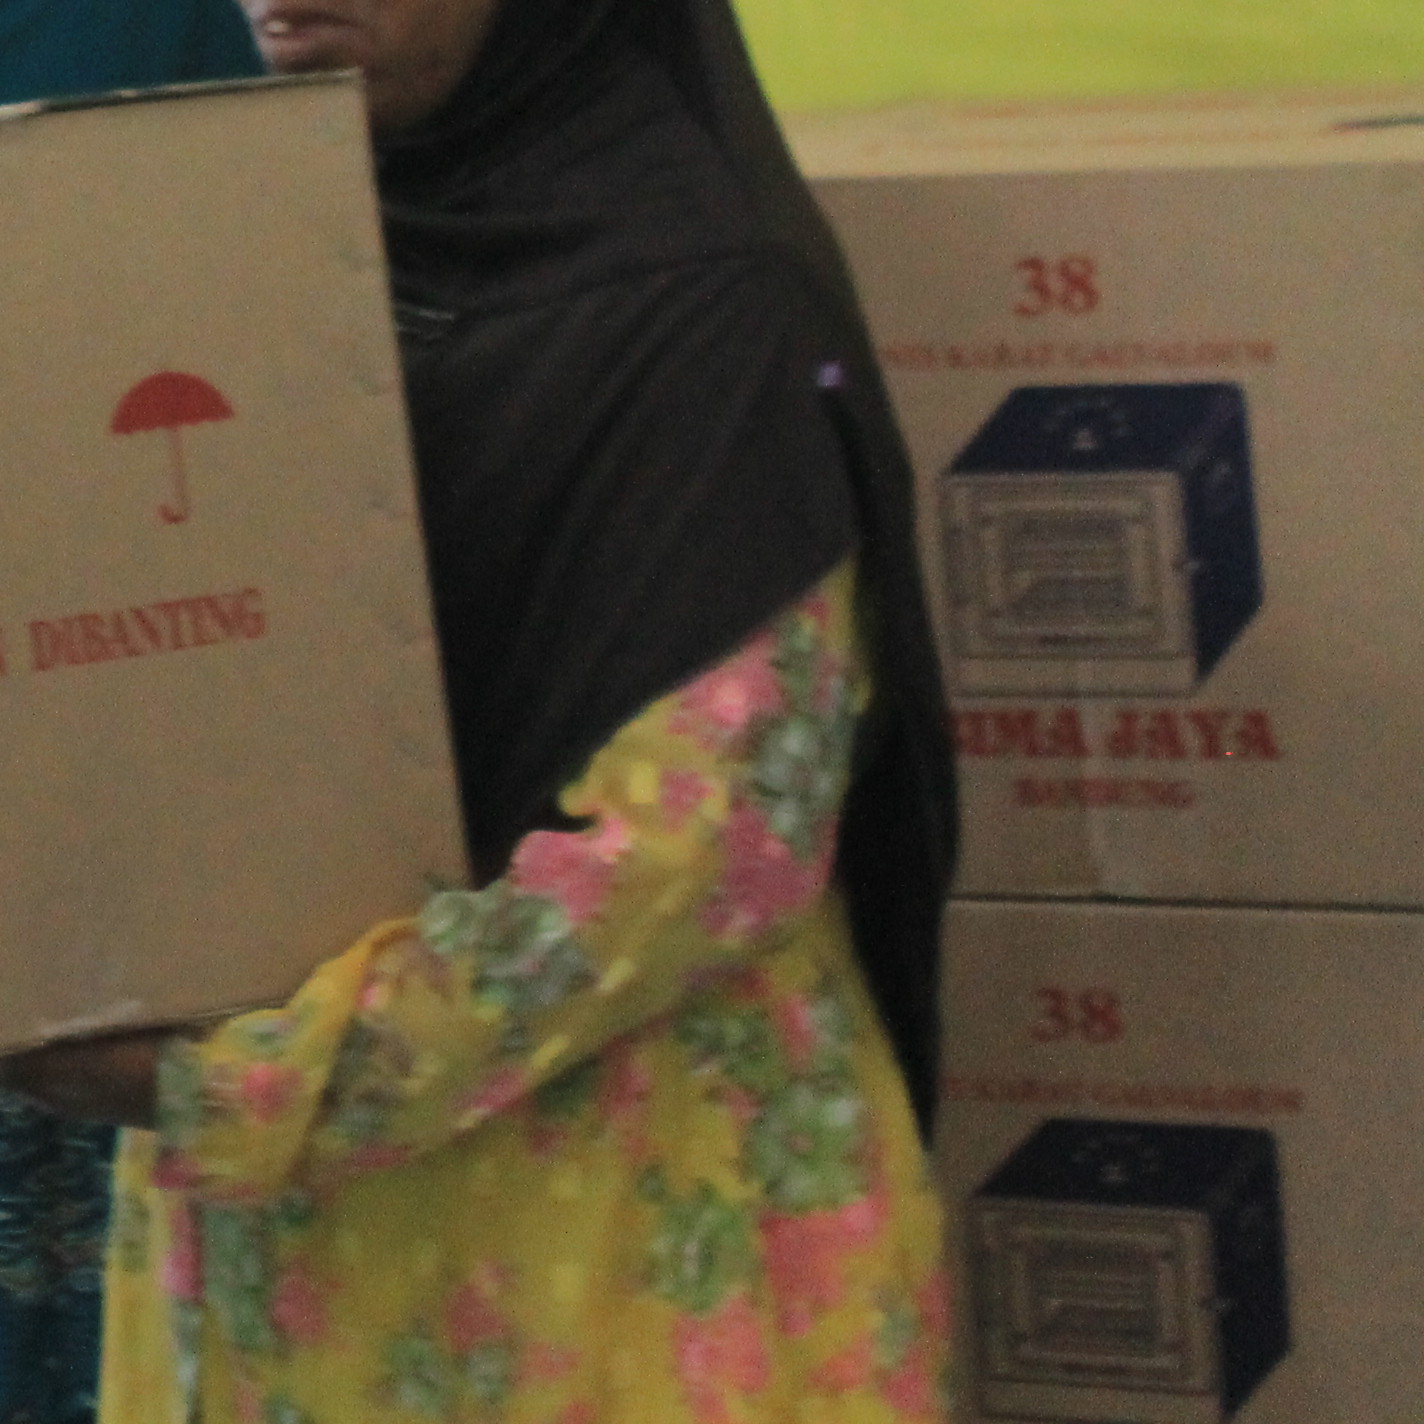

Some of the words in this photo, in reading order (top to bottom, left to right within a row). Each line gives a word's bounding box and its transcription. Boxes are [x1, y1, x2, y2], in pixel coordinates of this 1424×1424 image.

[1012, 257, 1100, 317] 38
[28, 586, 266, 672] DIBANTING
[1107, 708, 1281, 761] JAYA
[1030, 986, 1124, 1044] 38
